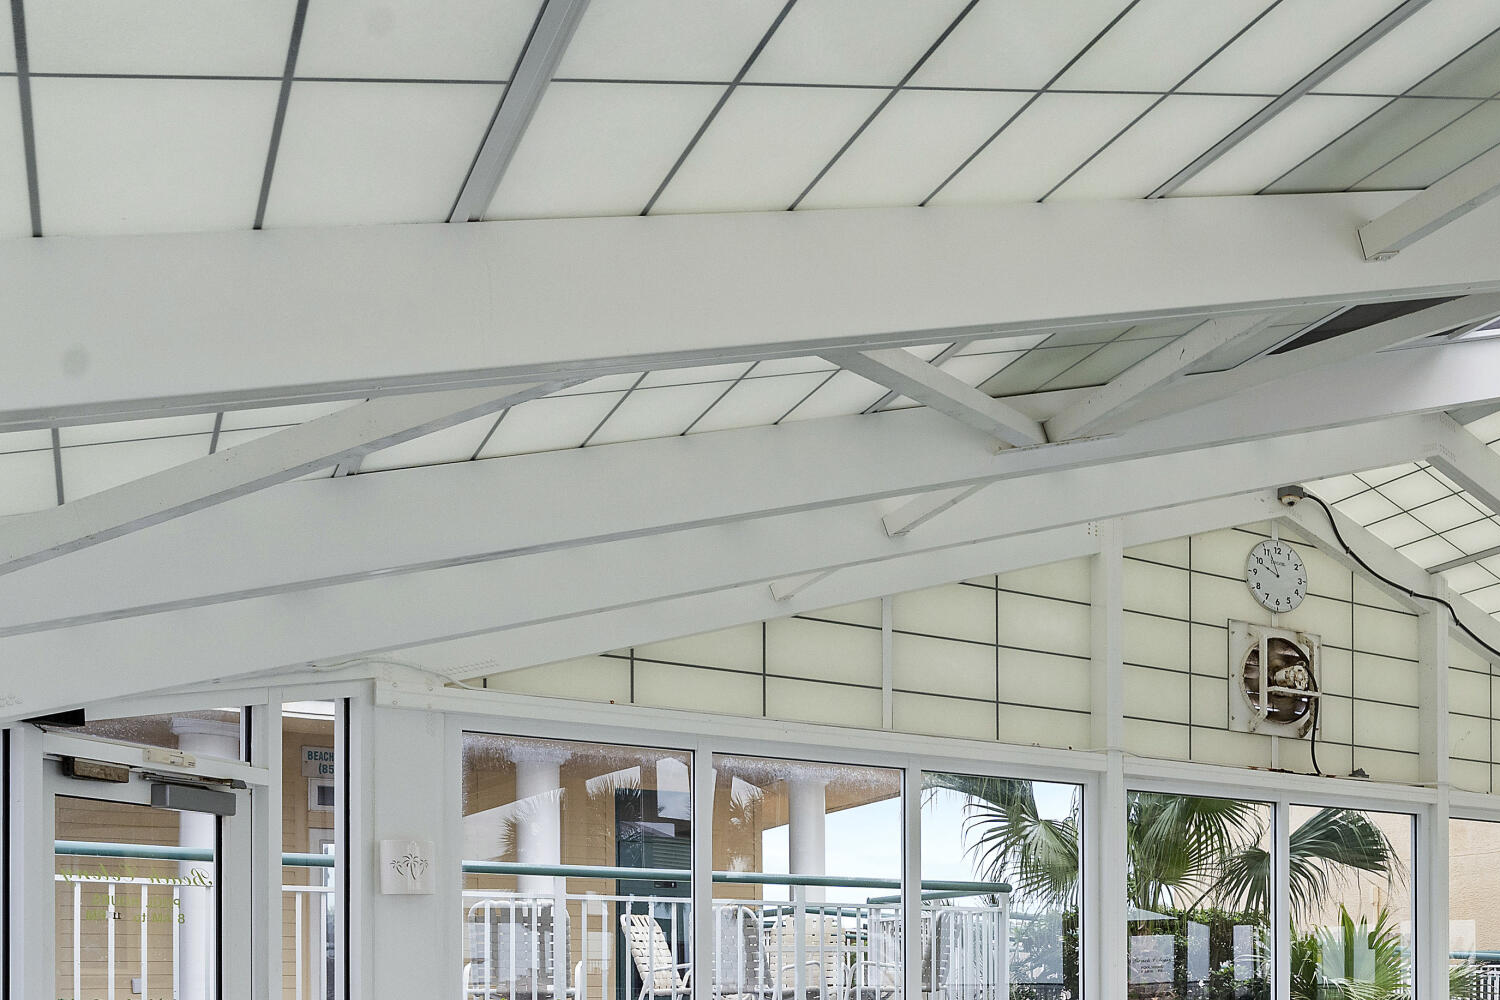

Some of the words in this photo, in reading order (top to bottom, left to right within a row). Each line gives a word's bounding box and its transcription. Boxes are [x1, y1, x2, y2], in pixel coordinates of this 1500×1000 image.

[1264, 548, 1270, 556] 11
[1274, 547, 1281, 555] 12
[307, 751, 334, 761] BEACH
